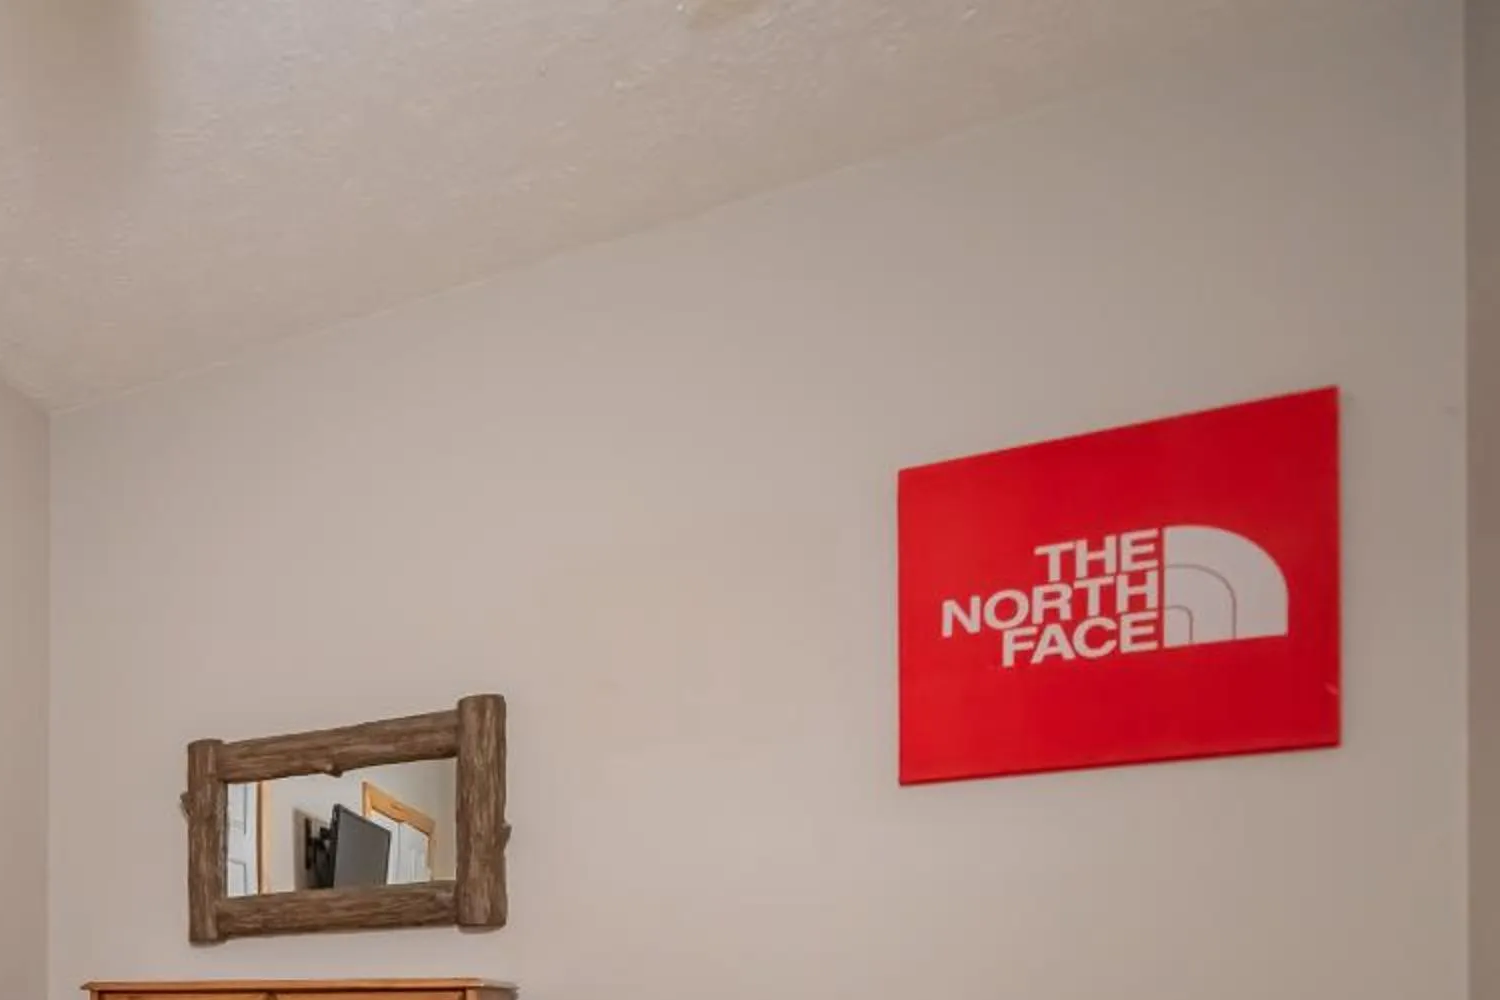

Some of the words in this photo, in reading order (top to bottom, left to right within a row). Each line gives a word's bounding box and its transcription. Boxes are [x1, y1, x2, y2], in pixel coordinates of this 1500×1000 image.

[1034, 527, 1159, 583] THE
[941, 570, 1159, 639] NORTH
[1002, 611, 1158, 669] FACE
